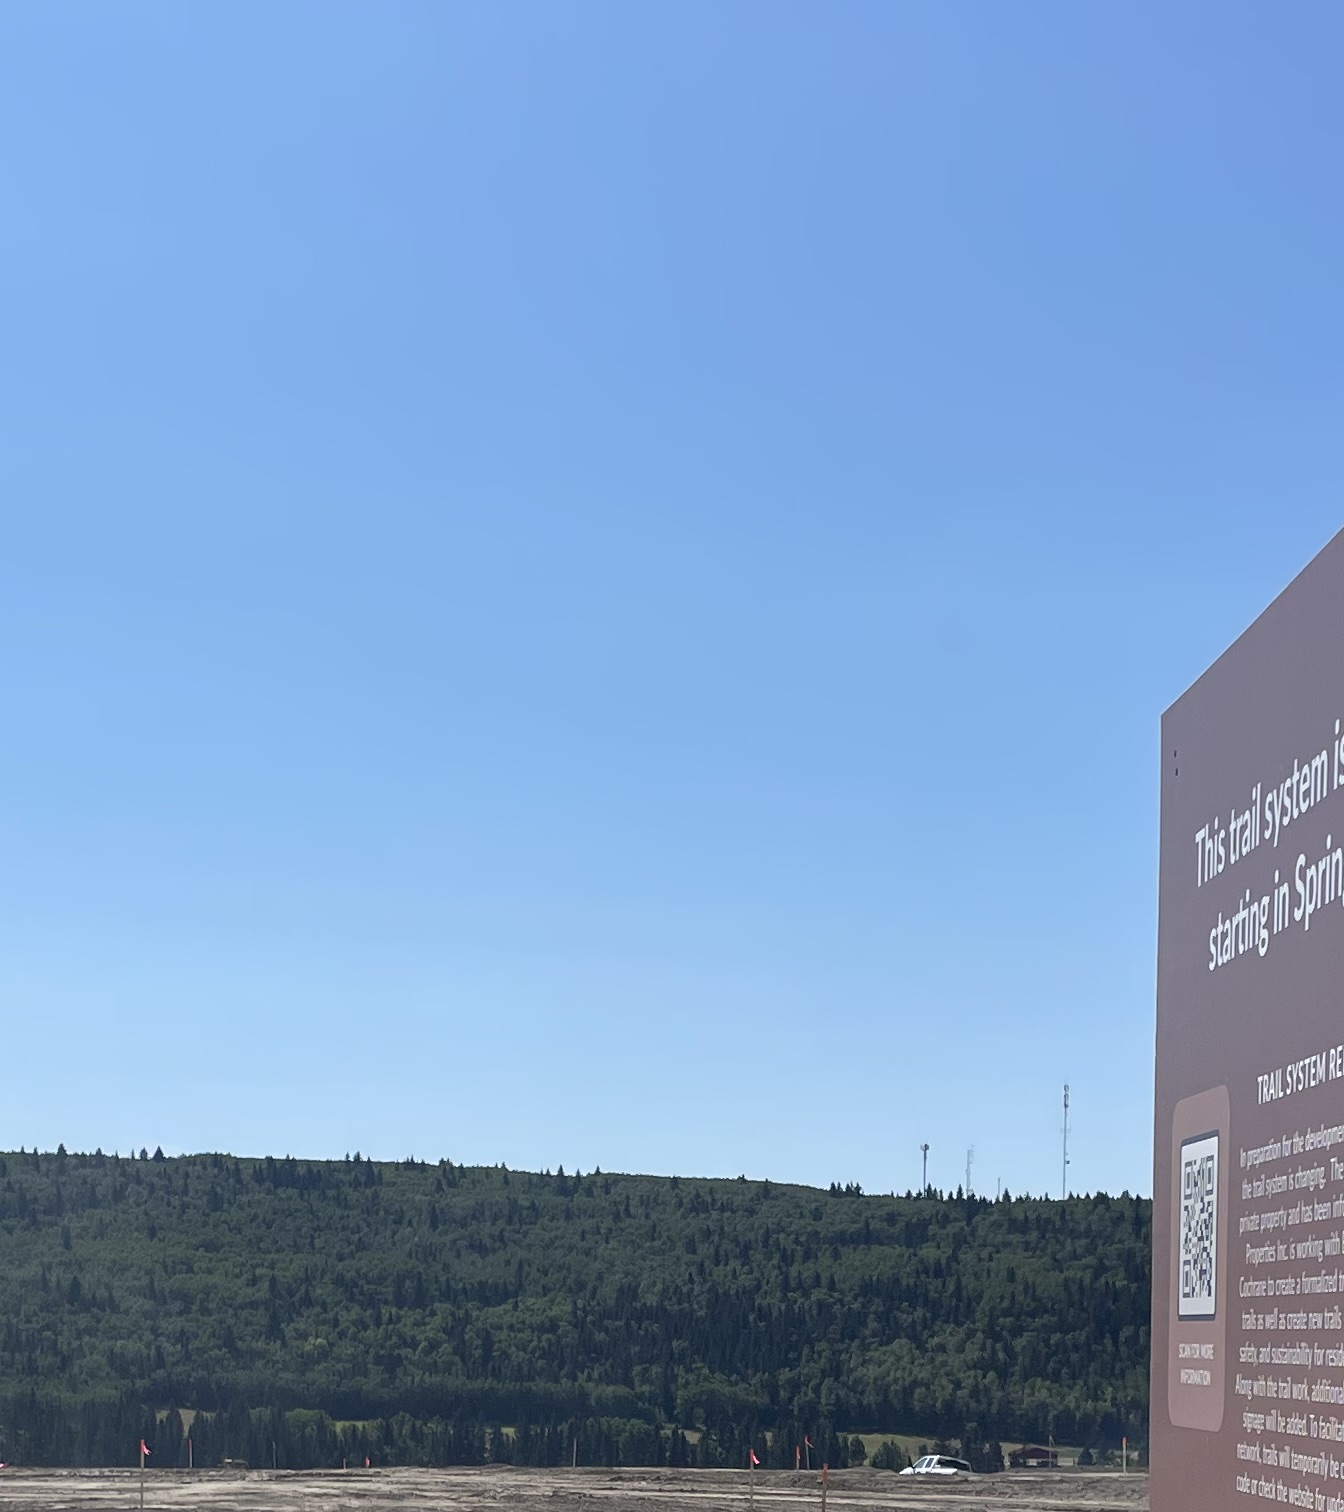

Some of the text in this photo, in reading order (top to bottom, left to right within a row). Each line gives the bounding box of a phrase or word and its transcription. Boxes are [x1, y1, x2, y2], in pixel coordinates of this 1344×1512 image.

[1195, 816, 1225, 887] This
[1229, 782, 1261, 864] trail
[1263, 749, 1327, 847] system
[1208, 888, 1270, 970] starting
[1273, 869, 1289, 934] in
[1257, 1068, 1283, 1104] TRAIL
[1285, 1051, 1326, 1095] SYSTEM
[1329, 1156, 1343, 1181] The
[1323, 1230, 1340, 1256] with
[1323, 1305, 1341, 1329] trails
[1329, 1453, 1339, 1478] be
